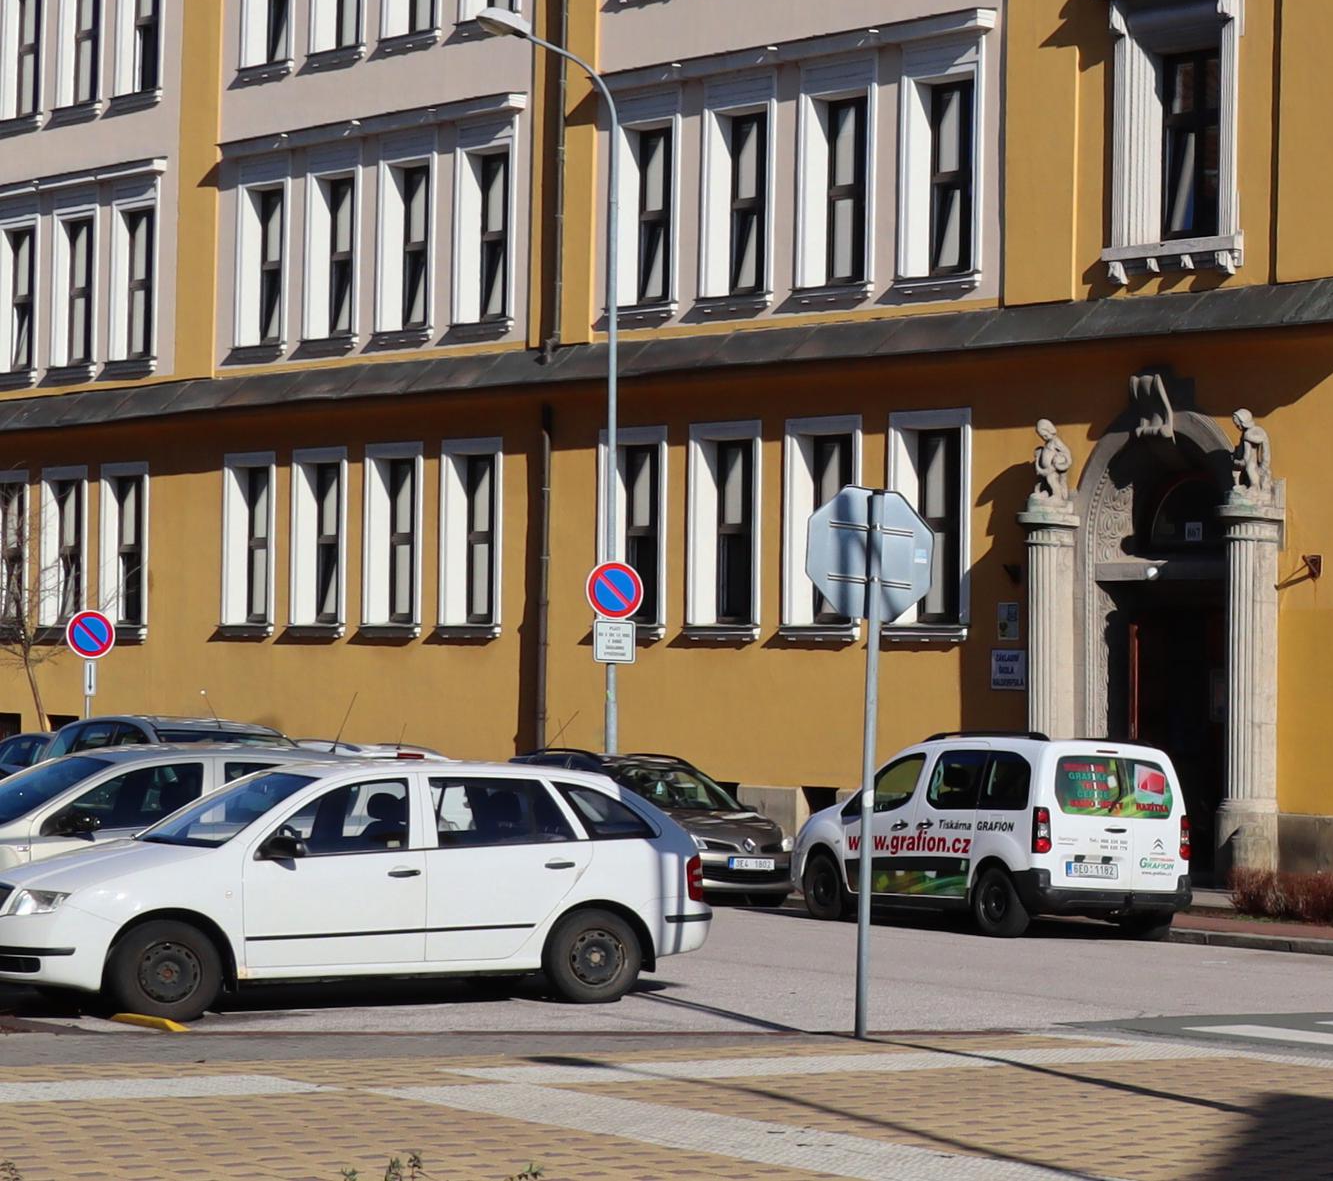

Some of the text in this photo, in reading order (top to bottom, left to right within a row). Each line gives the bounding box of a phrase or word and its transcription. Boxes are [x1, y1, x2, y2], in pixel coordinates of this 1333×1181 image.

[938, 820, 1014, 832] Tiskárna GRAFION
[848, 830, 972, 855] ww.grafion.cz
[1095, 865, 1114, 876] 1182
